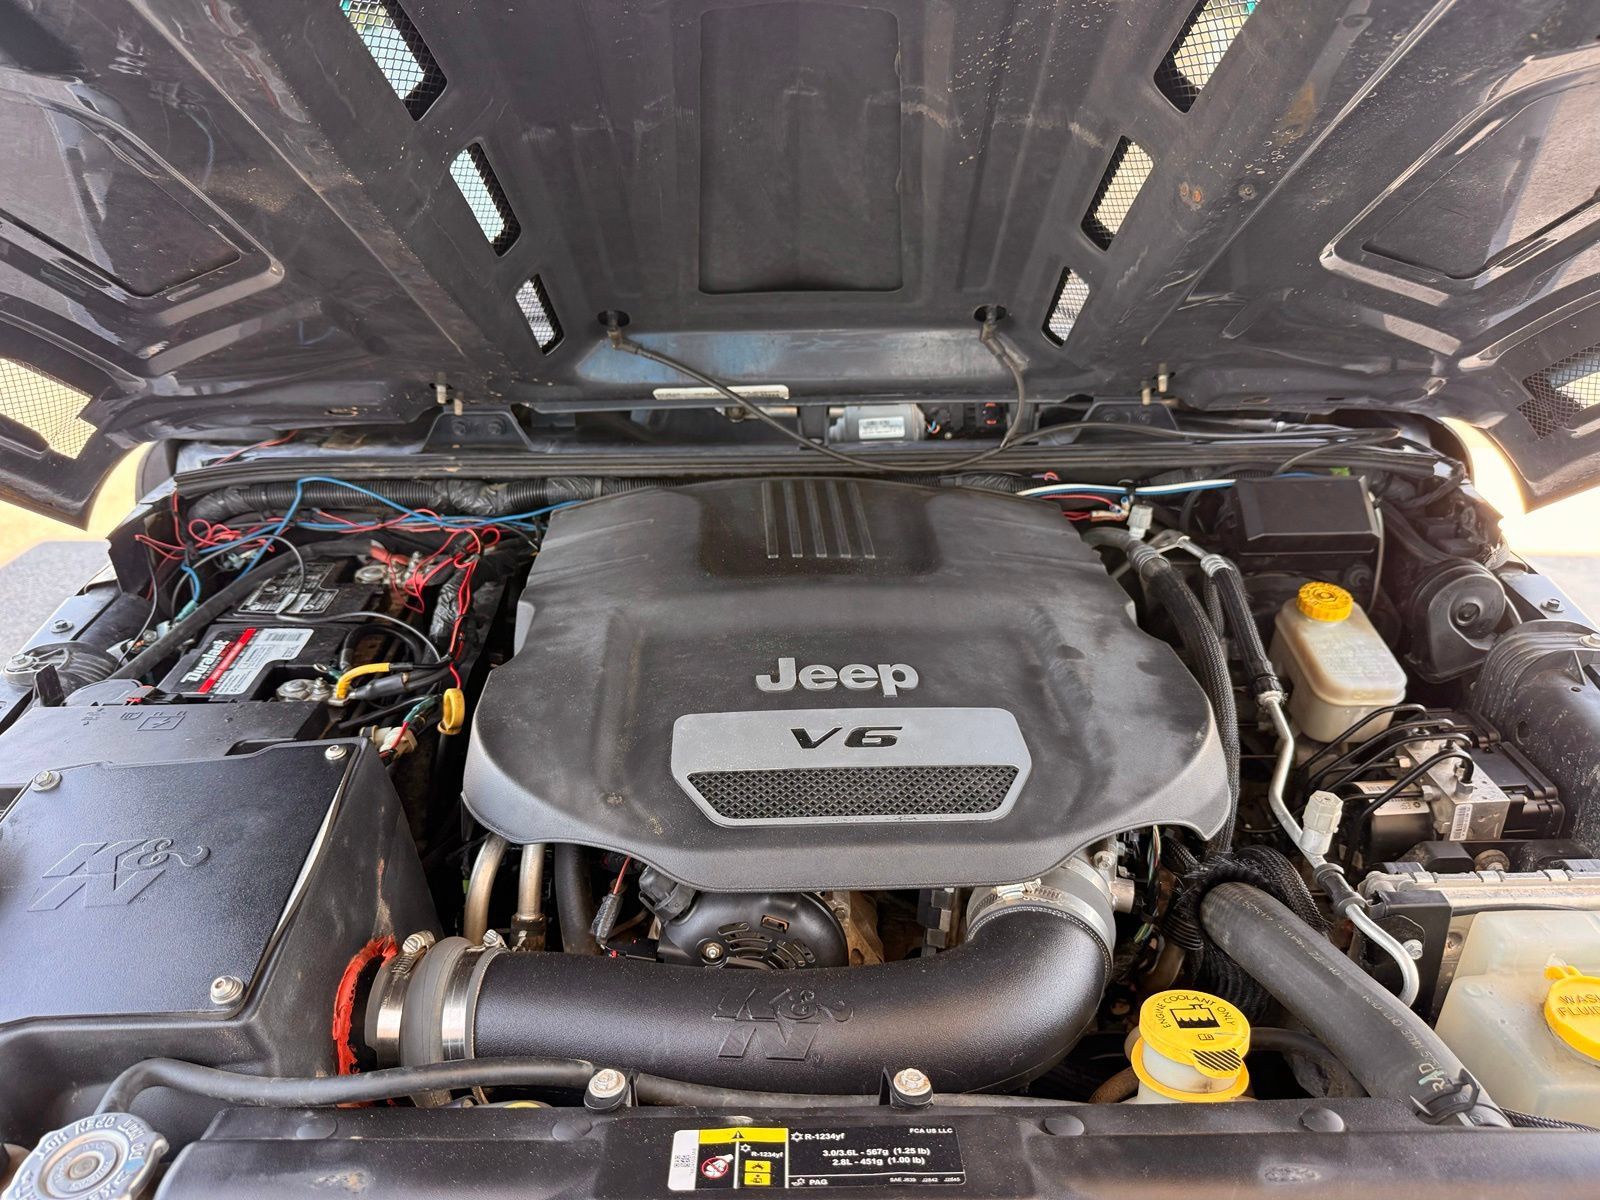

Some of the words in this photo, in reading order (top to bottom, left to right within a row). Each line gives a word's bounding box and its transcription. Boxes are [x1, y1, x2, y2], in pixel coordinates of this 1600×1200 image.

[180, 639, 231, 683] Duralast
[755, 657, 920, 698] Jeep
[790, 725, 903, 750] V6
[1163, 994, 1217, 1006] COOLANT
[1155, 1002, 1172, 1029] ENGINE
[1216, 1006, 1236, 1026] ONLY
[804, 1132, 846, 1141] R-1234yf
[822, 1149, 859, 1157] 3.0/3.6L
[893, 1147, 916, 1156] (1.25
[917, 1147, 931, 1156] lb)
[860, 1158, 883, 1166] 451g
[887, 1157, 910, 1165] (1.00
[912, 1156, 925, 1165] lb)
